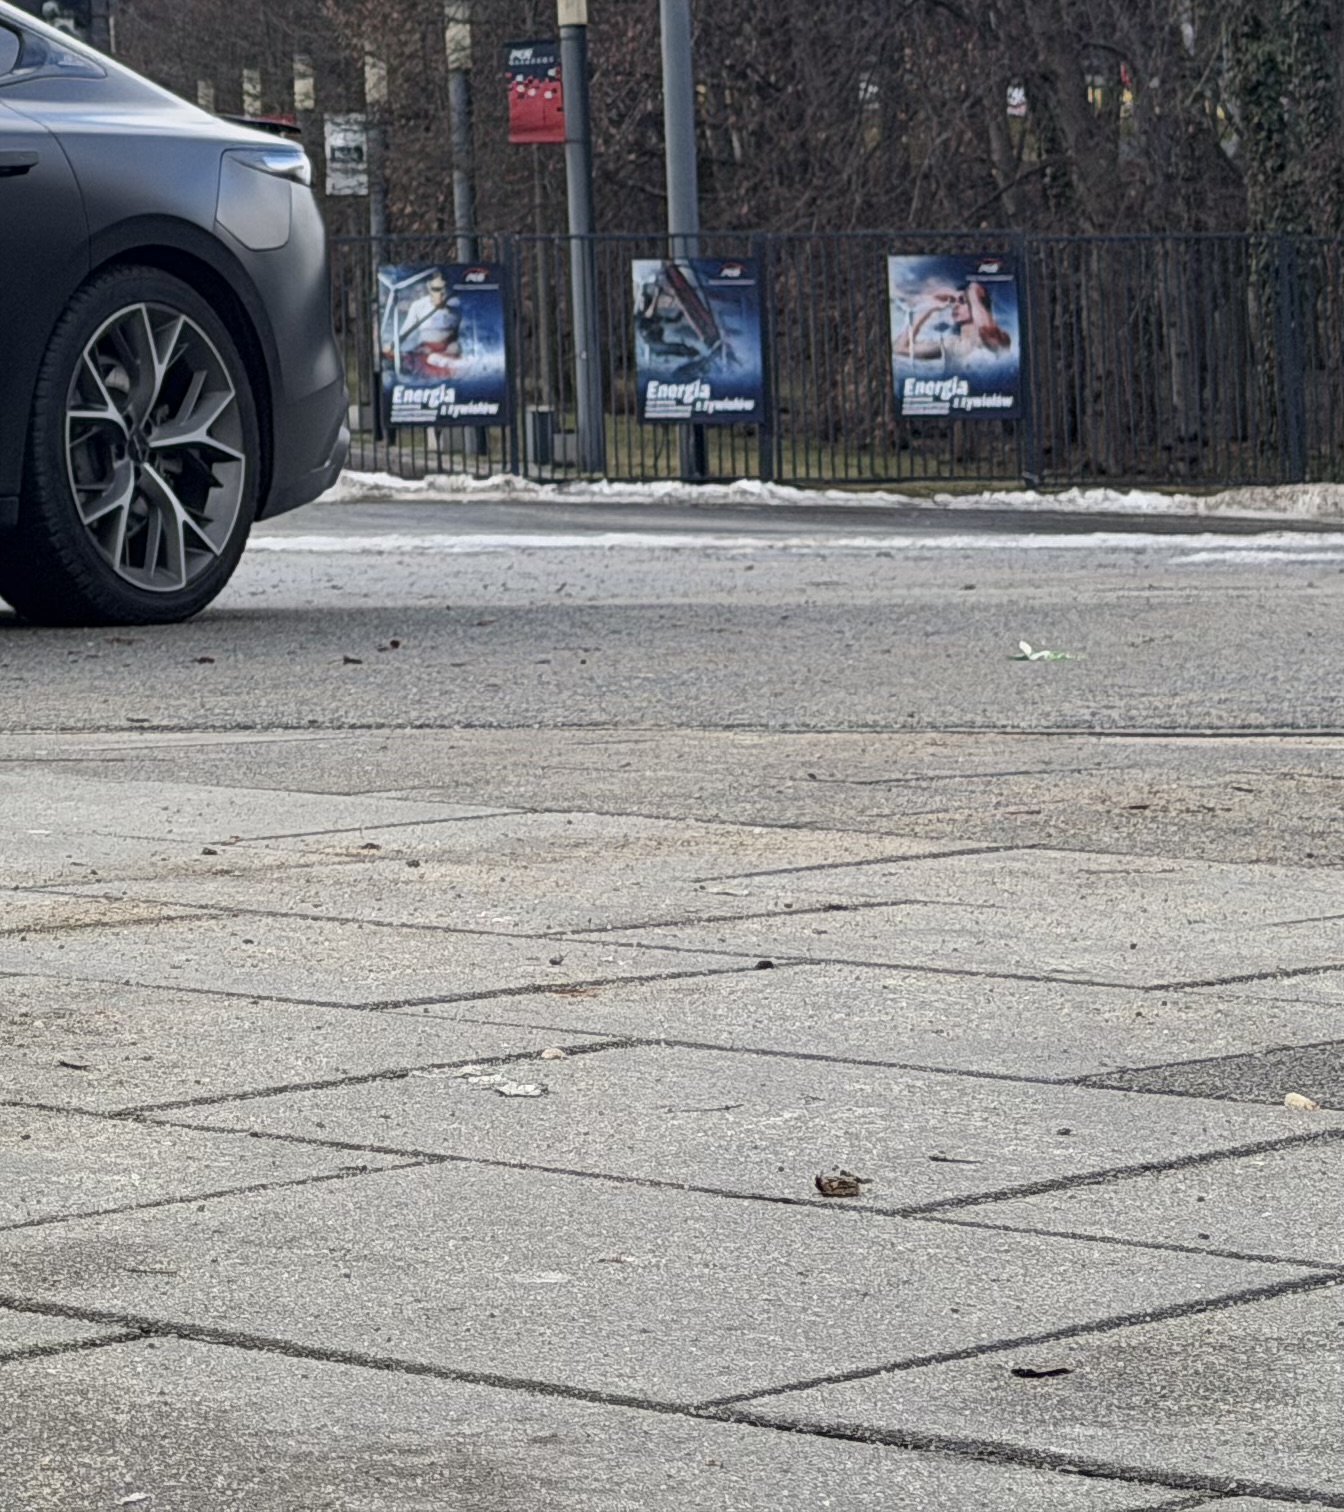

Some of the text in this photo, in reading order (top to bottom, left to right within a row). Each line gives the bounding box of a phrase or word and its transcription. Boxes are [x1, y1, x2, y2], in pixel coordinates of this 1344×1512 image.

[392, 384, 455, 408] Energia
[646, 379, 711, 404] Energia
[904, 375, 968, 401] Energia
